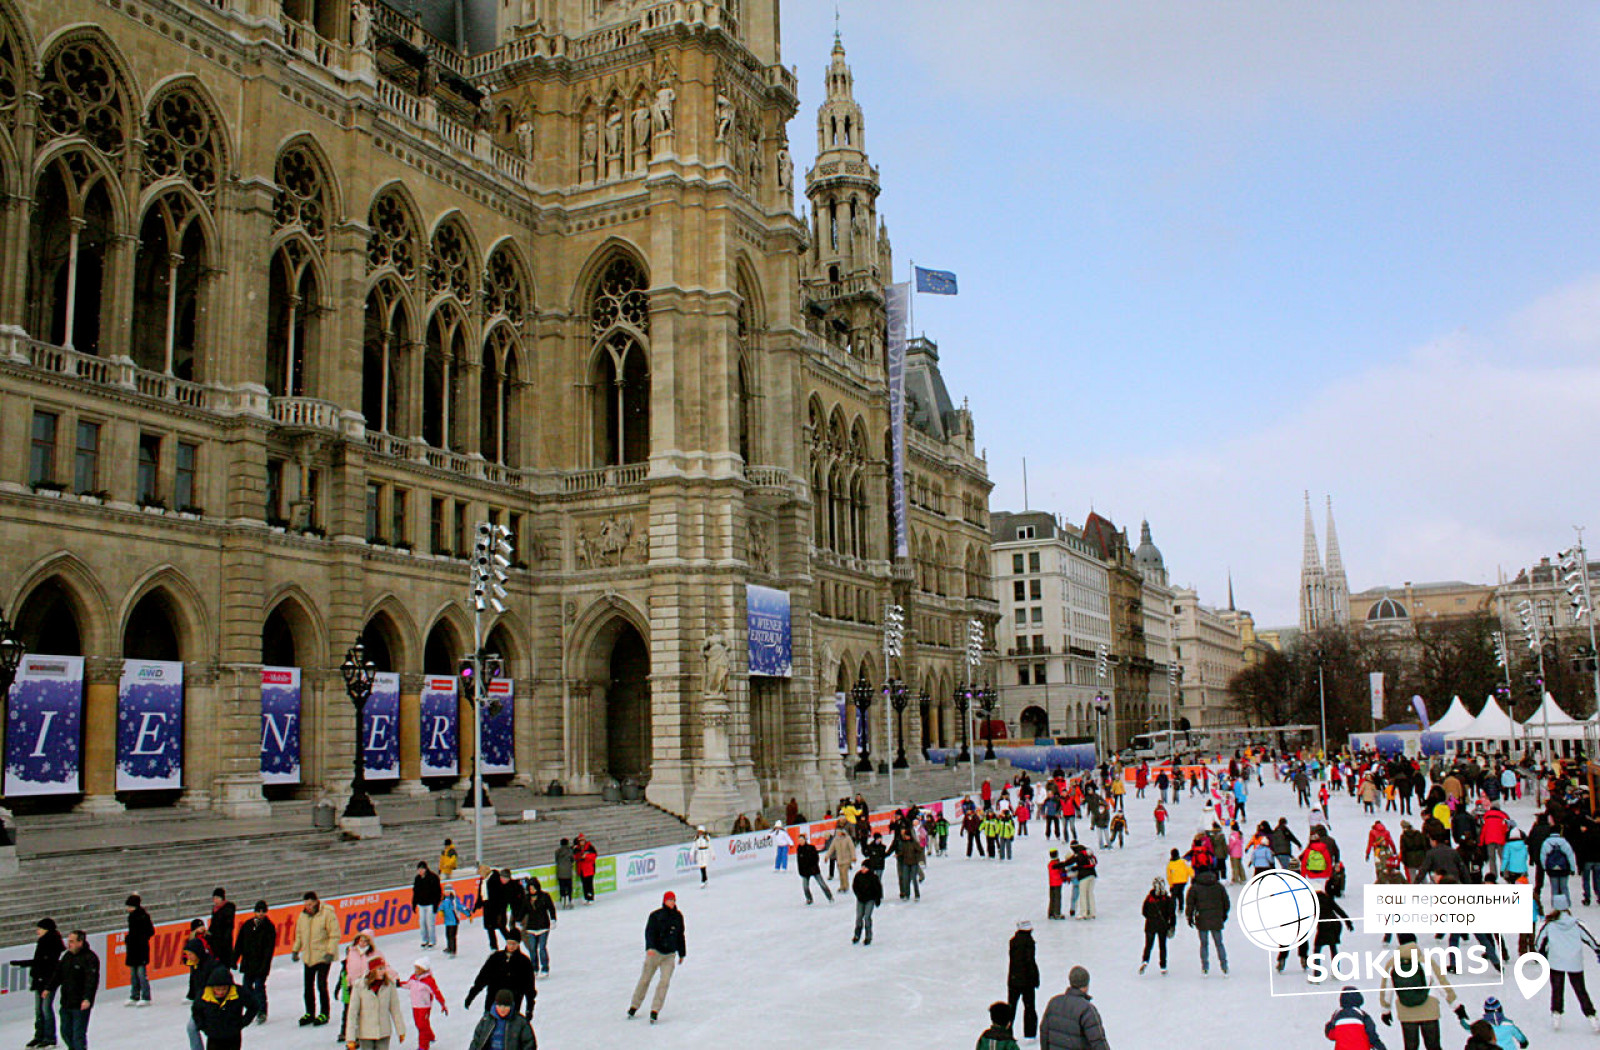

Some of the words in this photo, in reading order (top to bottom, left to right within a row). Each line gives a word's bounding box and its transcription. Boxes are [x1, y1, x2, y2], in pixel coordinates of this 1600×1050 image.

[138, 668, 164, 678] AWD
[130, 712, 167, 755] E
[261, 713, 296, 752] N
[365, 714, 390, 751] E
[428, 715, 450, 749] R
[675, 851, 699, 868] AW
[735, 838, 752, 854] Bank
[626, 858, 656, 877] AWD
[344, 898, 412, 935] radio
